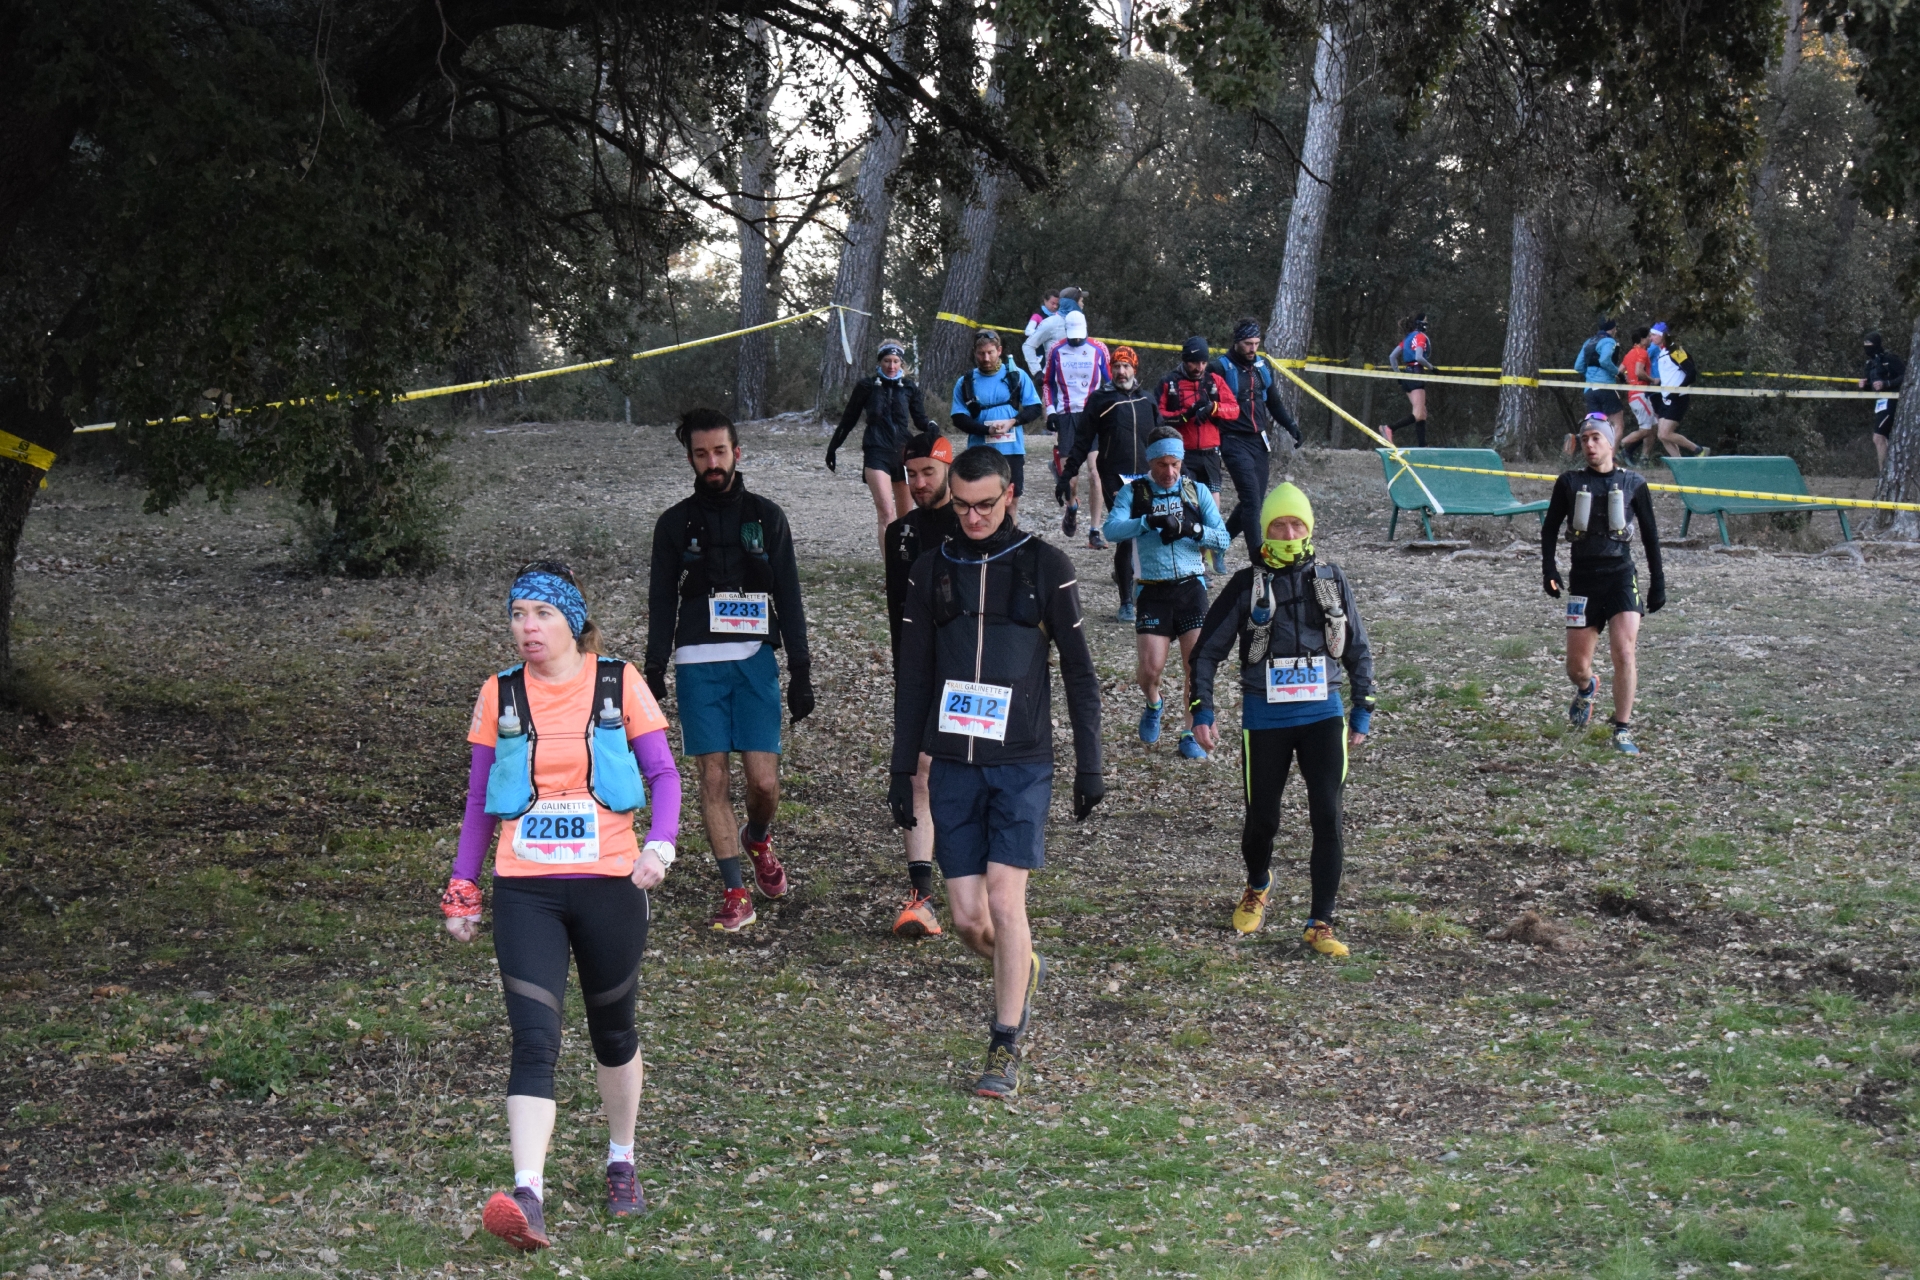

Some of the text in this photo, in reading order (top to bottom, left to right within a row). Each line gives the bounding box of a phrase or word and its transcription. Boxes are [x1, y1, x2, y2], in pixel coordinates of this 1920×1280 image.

[718, 602, 759, 617] 2233
[1275, 668, 1318, 685] 2256
[947, 682, 963, 690] TRAIL
[965, 684, 1002, 694] GALINETTE
[949, 694, 998, 717] 2512
[541, 802, 587, 810] GALINETTE
[526, 816, 585, 839] 2268
